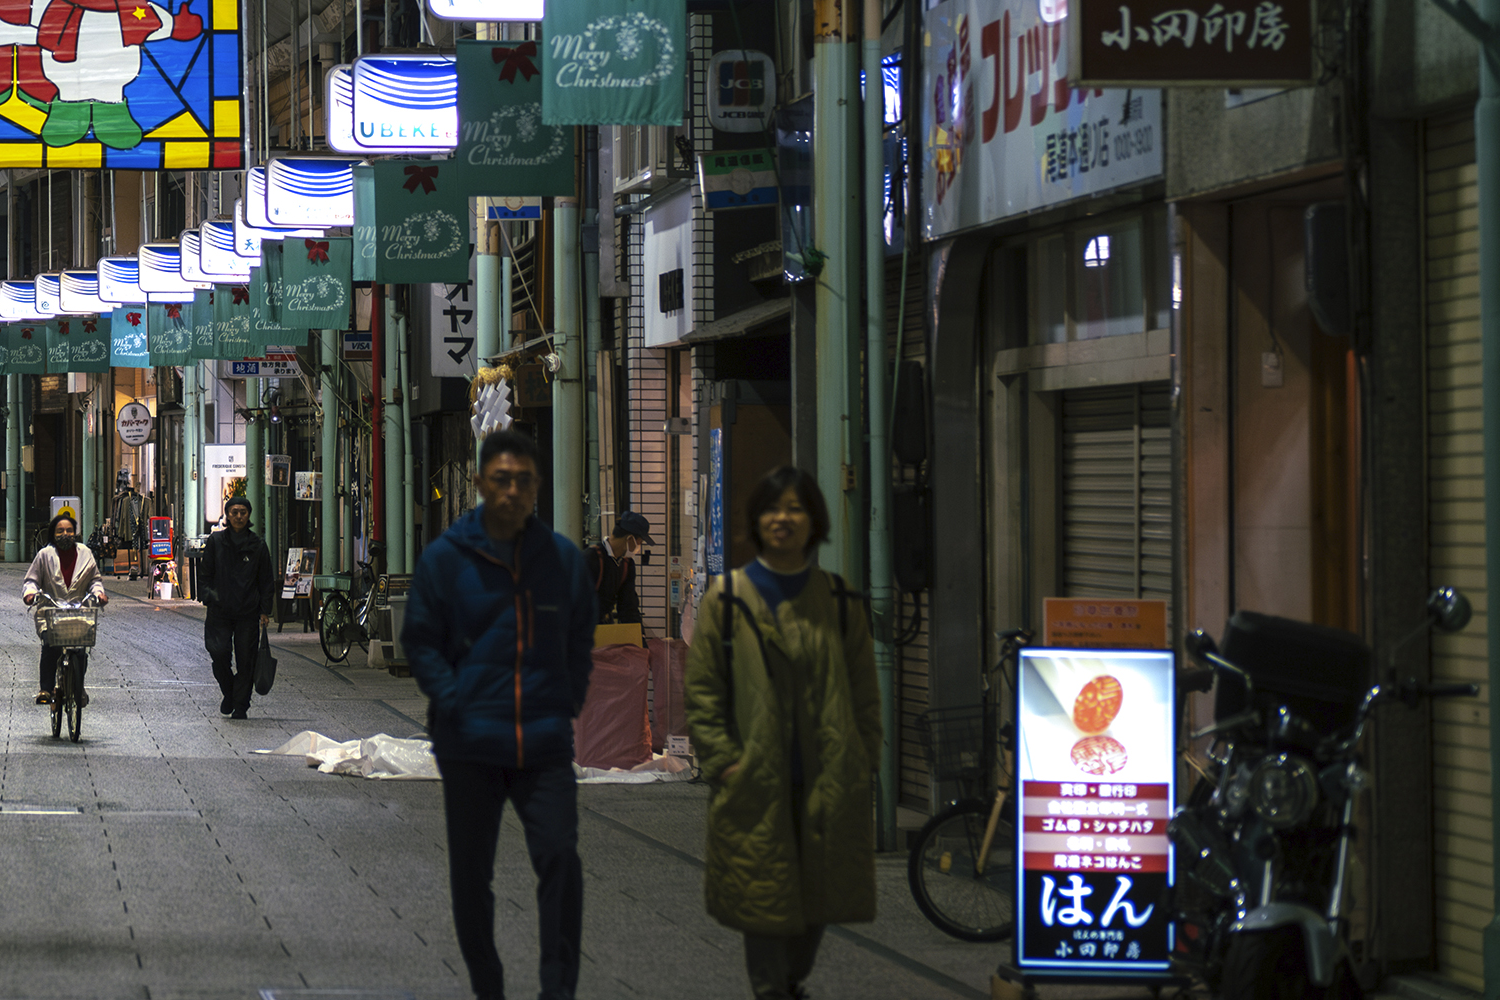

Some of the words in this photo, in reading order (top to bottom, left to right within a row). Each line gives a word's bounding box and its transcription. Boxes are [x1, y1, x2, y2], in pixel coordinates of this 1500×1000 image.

[550, 34, 610, 67] Merry
[556, 62, 645, 88] Christmas
[720, 79, 764, 89] JCB
[360, 121, 440, 138] UBEKE
[463, 121, 512, 148] Merry
[468, 144, 540, 166] Christmas
[381, 225, 421, 246] Merry
[385, 242, 442, 260] Christmas
[286, 284, 315, 301] Merry
[288, 298, 329, 311] Christmas
[443, 244, 475, 365] オヤマ
[352, 342, 370, 350] VISA
[236, 363, 257, 373] 地酒
[121, 419, 149, 427] カバーマーク
[1041, 874, 1153, 926] はん
